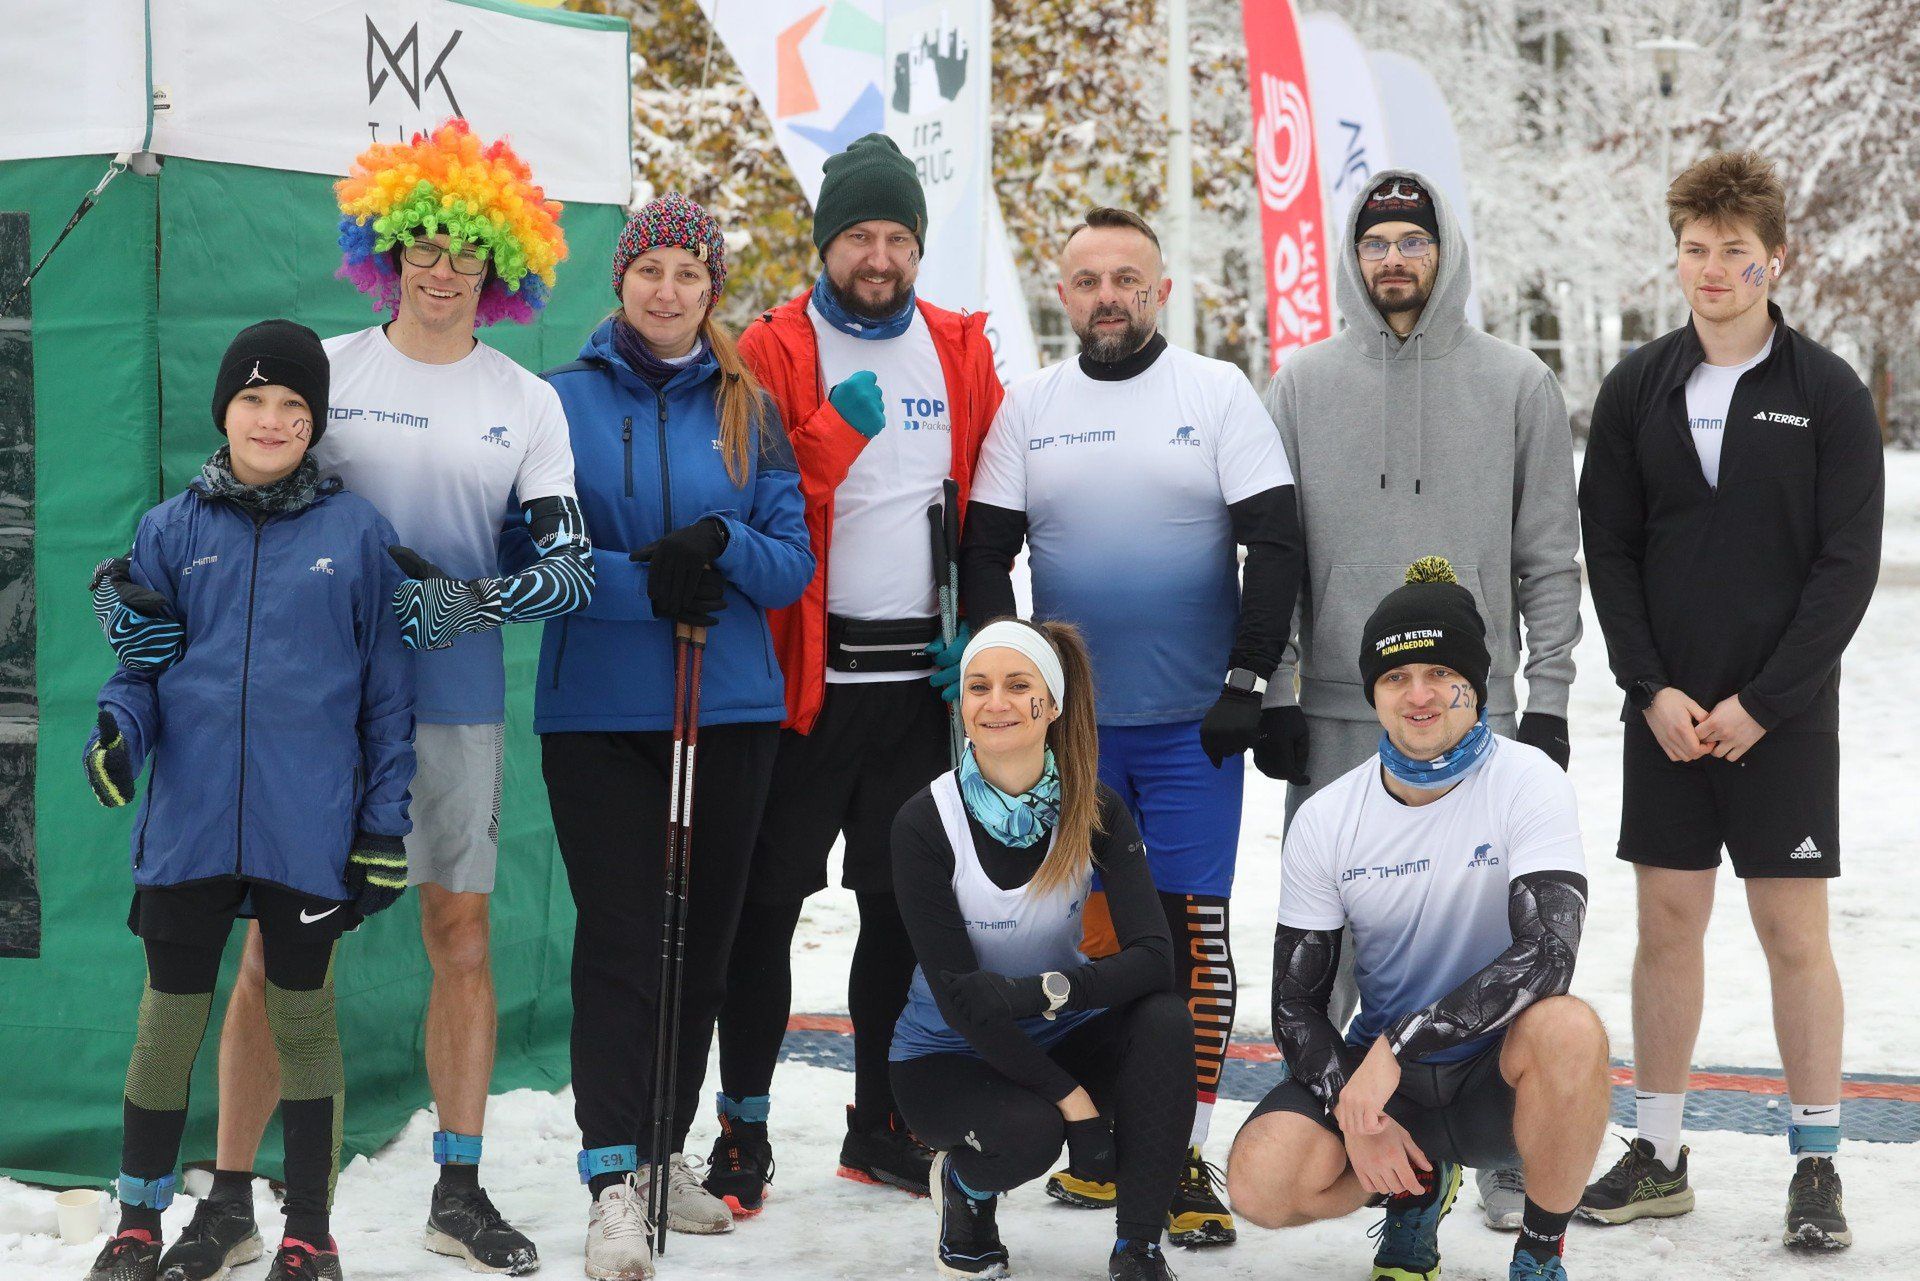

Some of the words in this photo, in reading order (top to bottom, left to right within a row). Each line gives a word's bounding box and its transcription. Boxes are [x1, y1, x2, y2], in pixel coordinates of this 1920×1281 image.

[901, 398, 945, 417] TOP
[1768, 411, 1811, 428] TERREX
[1404, 629, 1443, 640] WETERAN
[1381, 639, 1435, 657] RUNMAGEDDON
[1790, 850, 1822, 859] adidas
